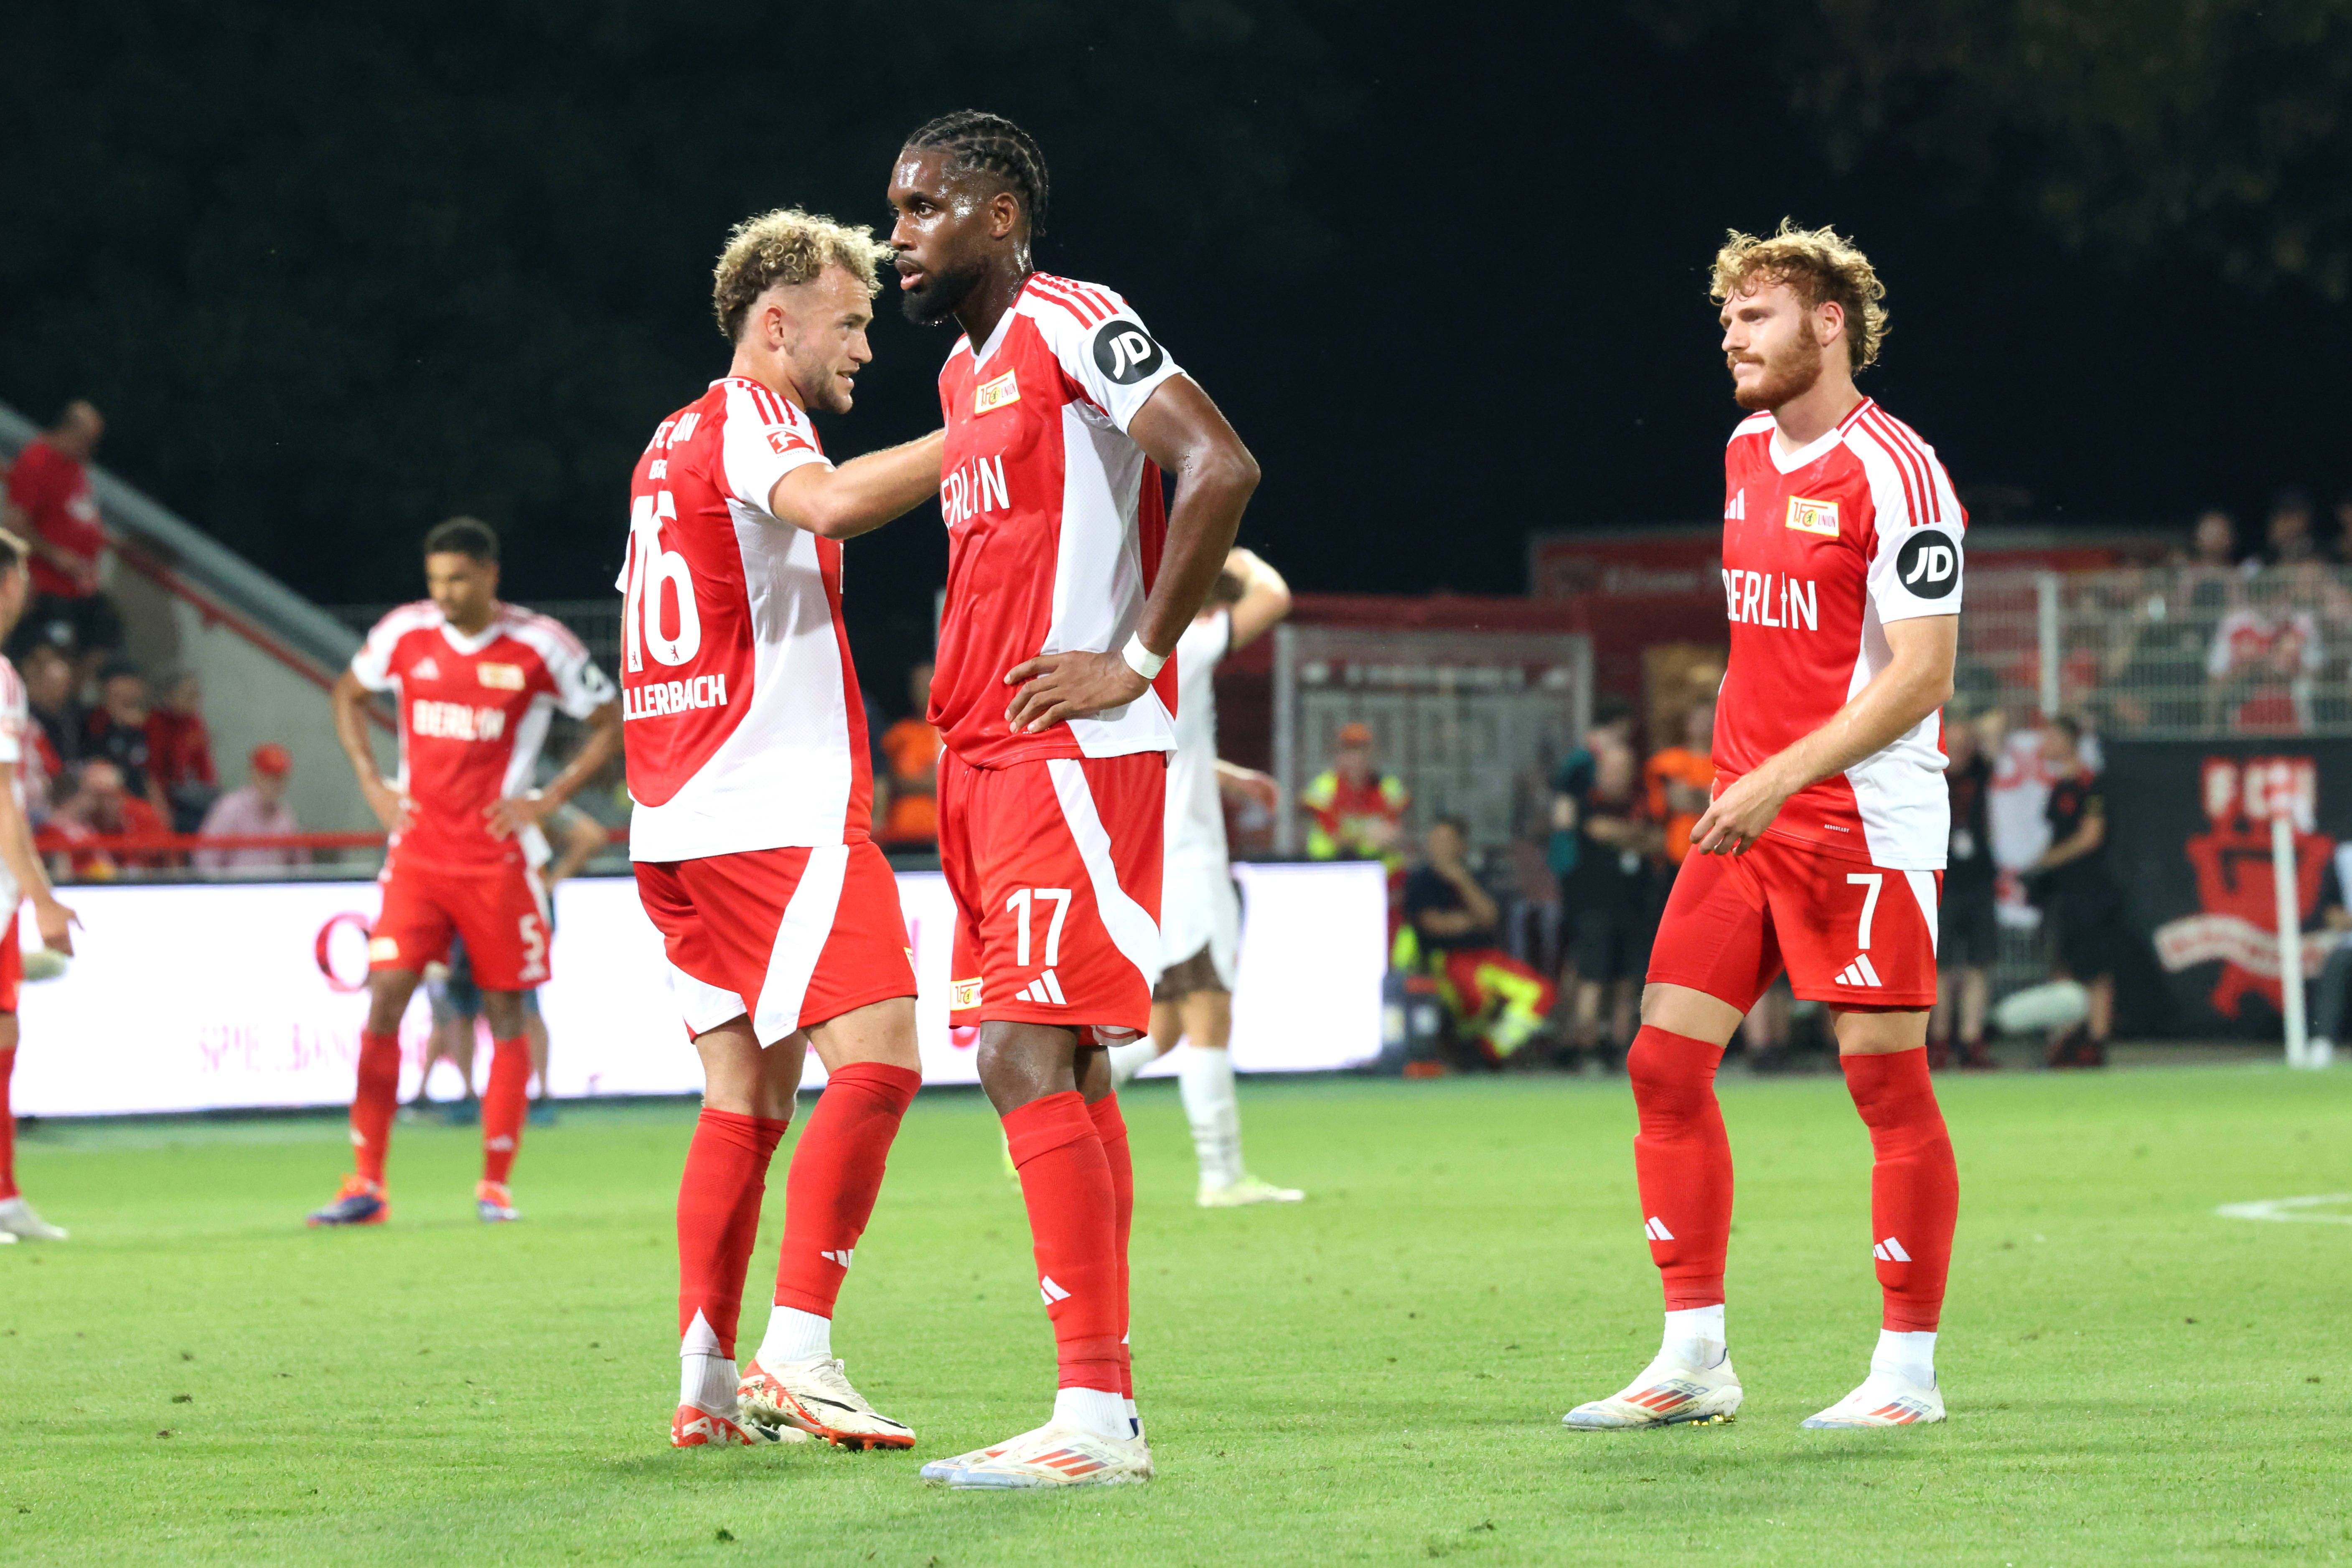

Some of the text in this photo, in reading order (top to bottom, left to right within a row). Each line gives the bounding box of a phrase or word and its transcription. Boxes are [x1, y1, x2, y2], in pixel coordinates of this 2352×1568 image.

[1109, 331, 1151, 379] JD
[1001, 383, 1016, 398] UNION
[941, 455, 1010, 529] ERLIN
[1818, 514, 1836, 528] UNION
[626, 490, 701, 673] 16
[1906, 545, 1953, 585] JD
[623, 673, 727, 722] LLERBACH
[412, 699, 506, 742] BERLIN
[1824, 823, 1850, 834] AEROREADY
[1006, 888, 1072, 966] 17
[1847, 873, 1882, 949] 7
[519, 914, 545, 961] 5
[1662, 1378, 1710, 1395] F50
[1895, 1395, 1932, 1413] F50
[1070, 1443, 1124, 1466] F50
